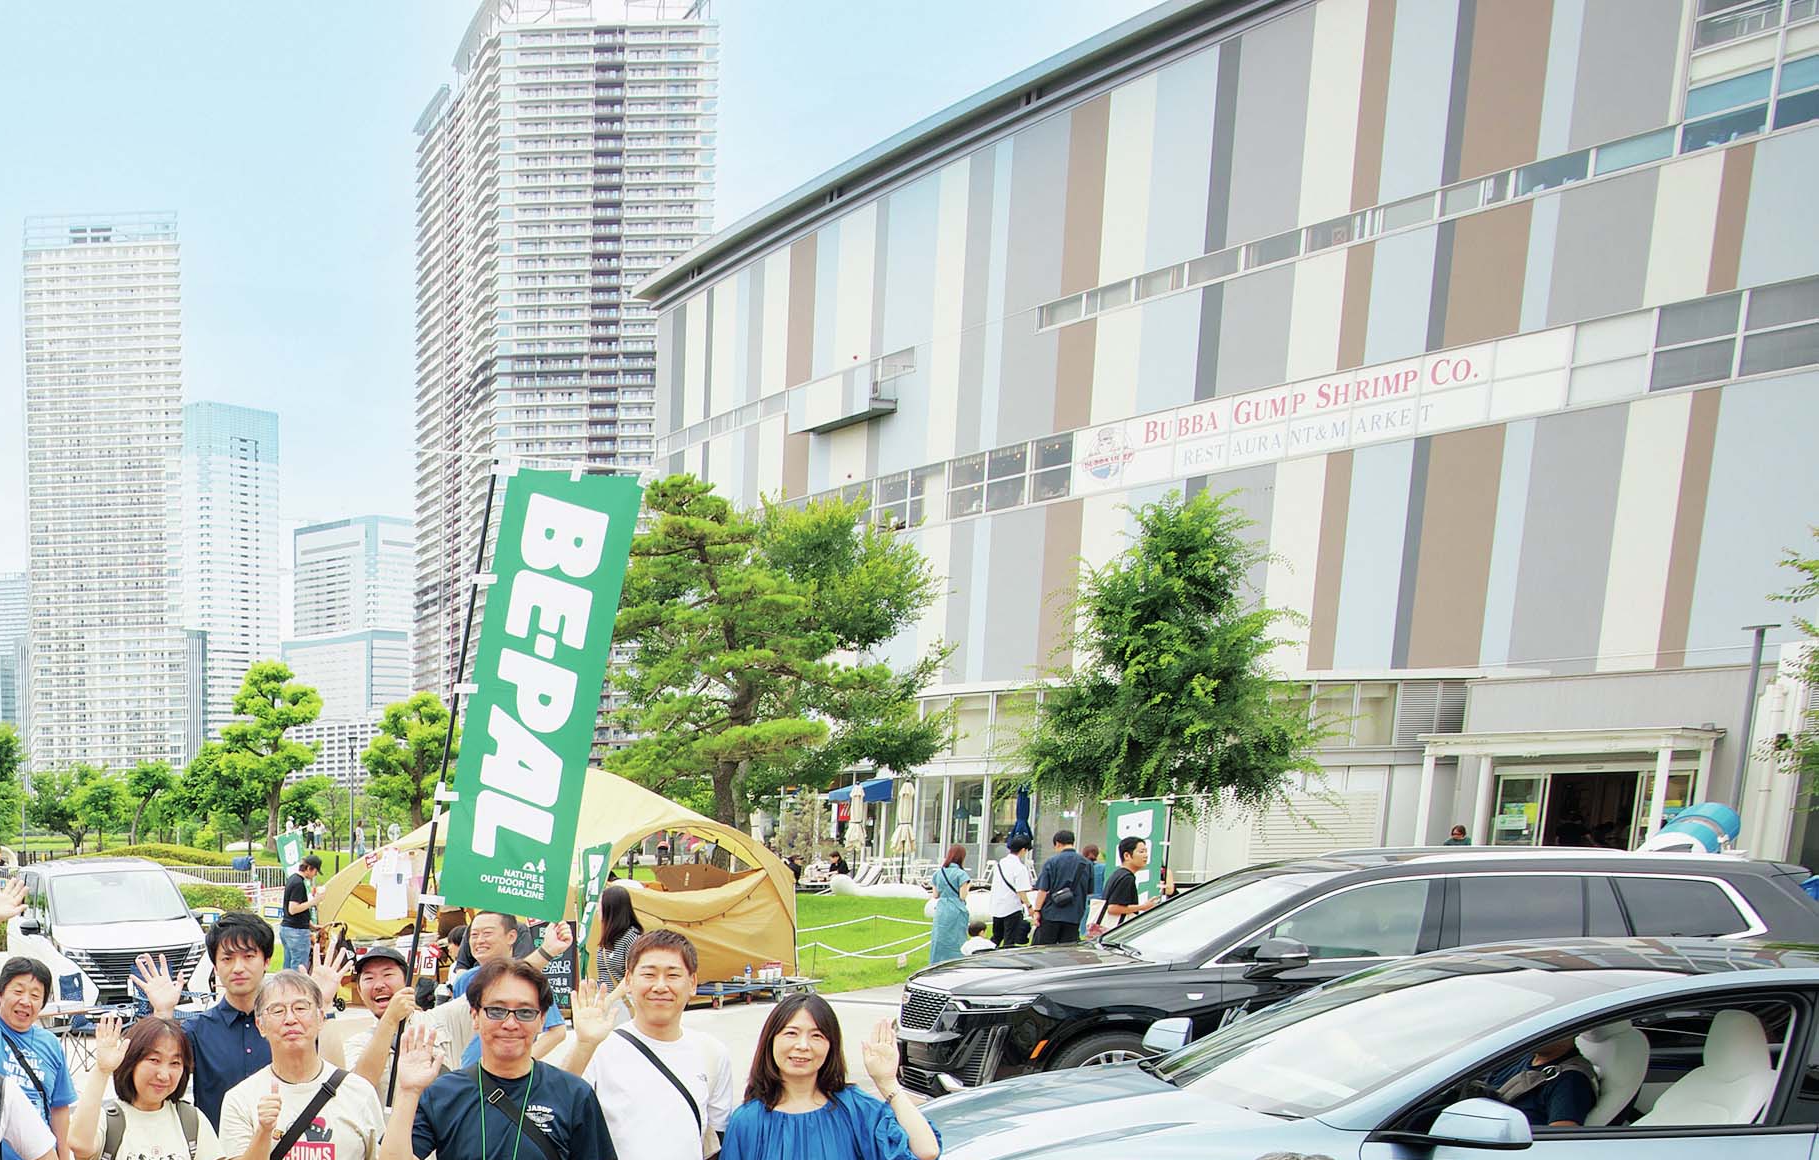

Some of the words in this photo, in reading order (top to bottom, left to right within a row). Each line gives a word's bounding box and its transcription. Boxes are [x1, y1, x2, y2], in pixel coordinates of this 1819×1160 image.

[1144, 411, 1218, 444] BUBBA
[1233, 393, 1306, 425] GUMP
[1316, 370, 1418, 409] SHRIMP
[1431, 358, 1478, 385] CO.
[471, 492, 609, 858] BE-PAL
[480, 874, 525, 888] OUTDOOR
[526, 881, 545, 892] LIFE
[503, 868, 538, 883] NATURE
[497, 885, 545, 900] MAGAZINE
